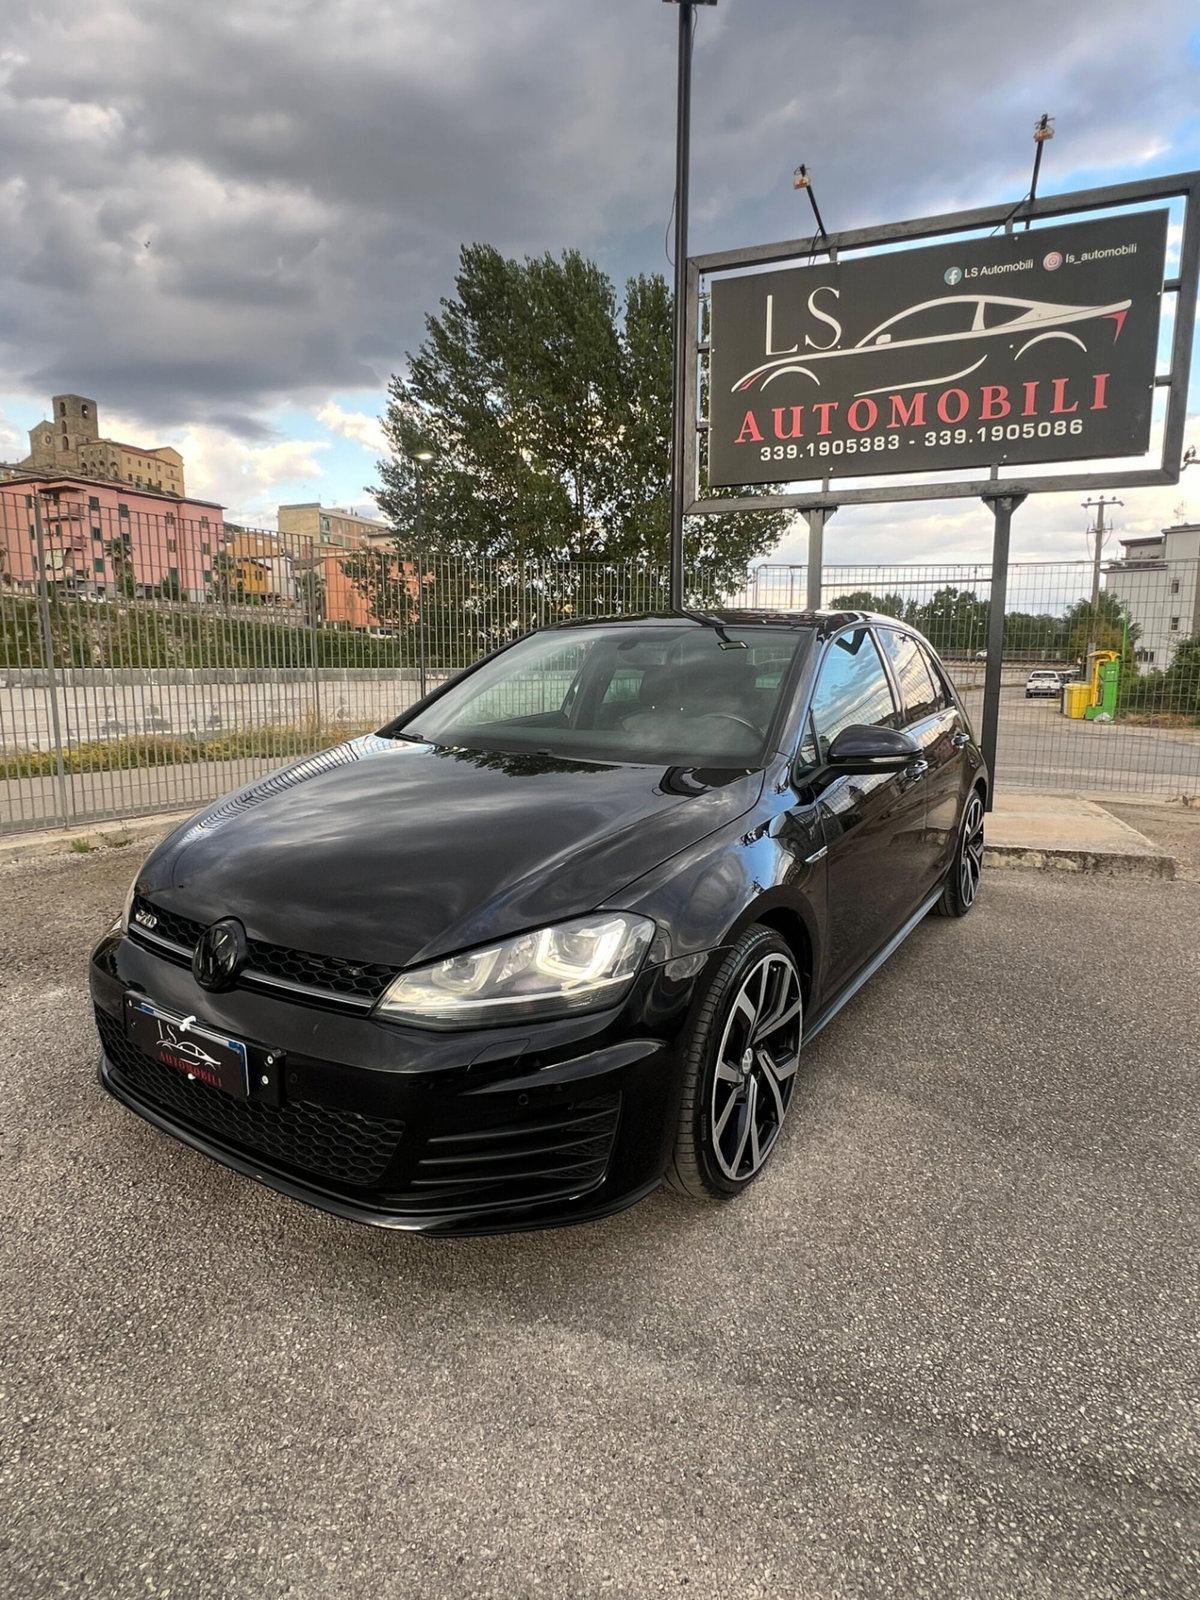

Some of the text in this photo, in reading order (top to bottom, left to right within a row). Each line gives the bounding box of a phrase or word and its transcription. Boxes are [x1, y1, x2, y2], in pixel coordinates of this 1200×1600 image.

[964, 259, 1034, 278] LS Automobili
[1065, 243, 1137, 264] ls_automobili
[734, 373, 1111, 443] AUTOMOBILI
[760, 435, 900, 461] 339.1905383
[924, 419, 1084, 447] 339.1905086
[160, 1050, 223, 1089] AUTOMOBILI
